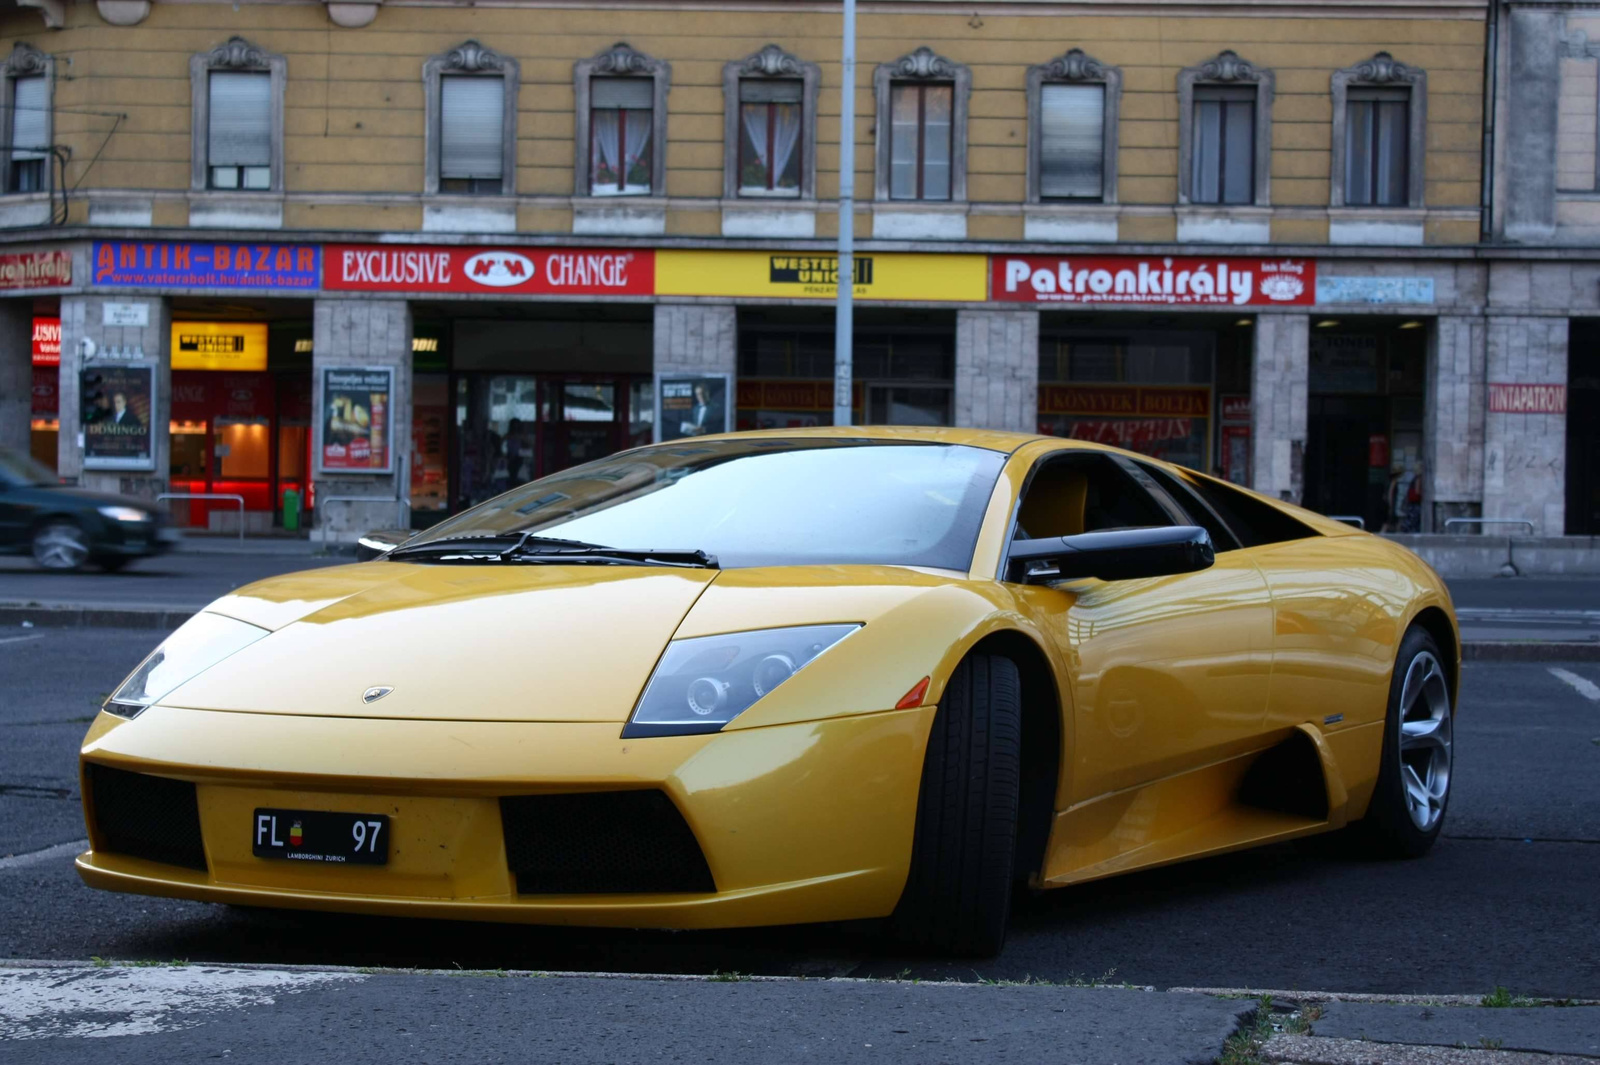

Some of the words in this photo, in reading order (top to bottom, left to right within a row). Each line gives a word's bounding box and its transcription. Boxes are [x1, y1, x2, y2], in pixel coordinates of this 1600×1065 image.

[342, 251, 450, 284] EXCLUSIVE
[546, 254, 628, 286] CHANGE
[1005, 258, 1253, 305] Patronkirály
[1489, 385, 1565, 411] TINTAPATRON
[89, 424, 147, 436] DOMINGO
[257, 815, 284, 846] FL
[352, 820, 382, 853] 97
[287, 852, 323, 861] LAMBORGHINI
[325, 855, 346, 863] ZURICH
